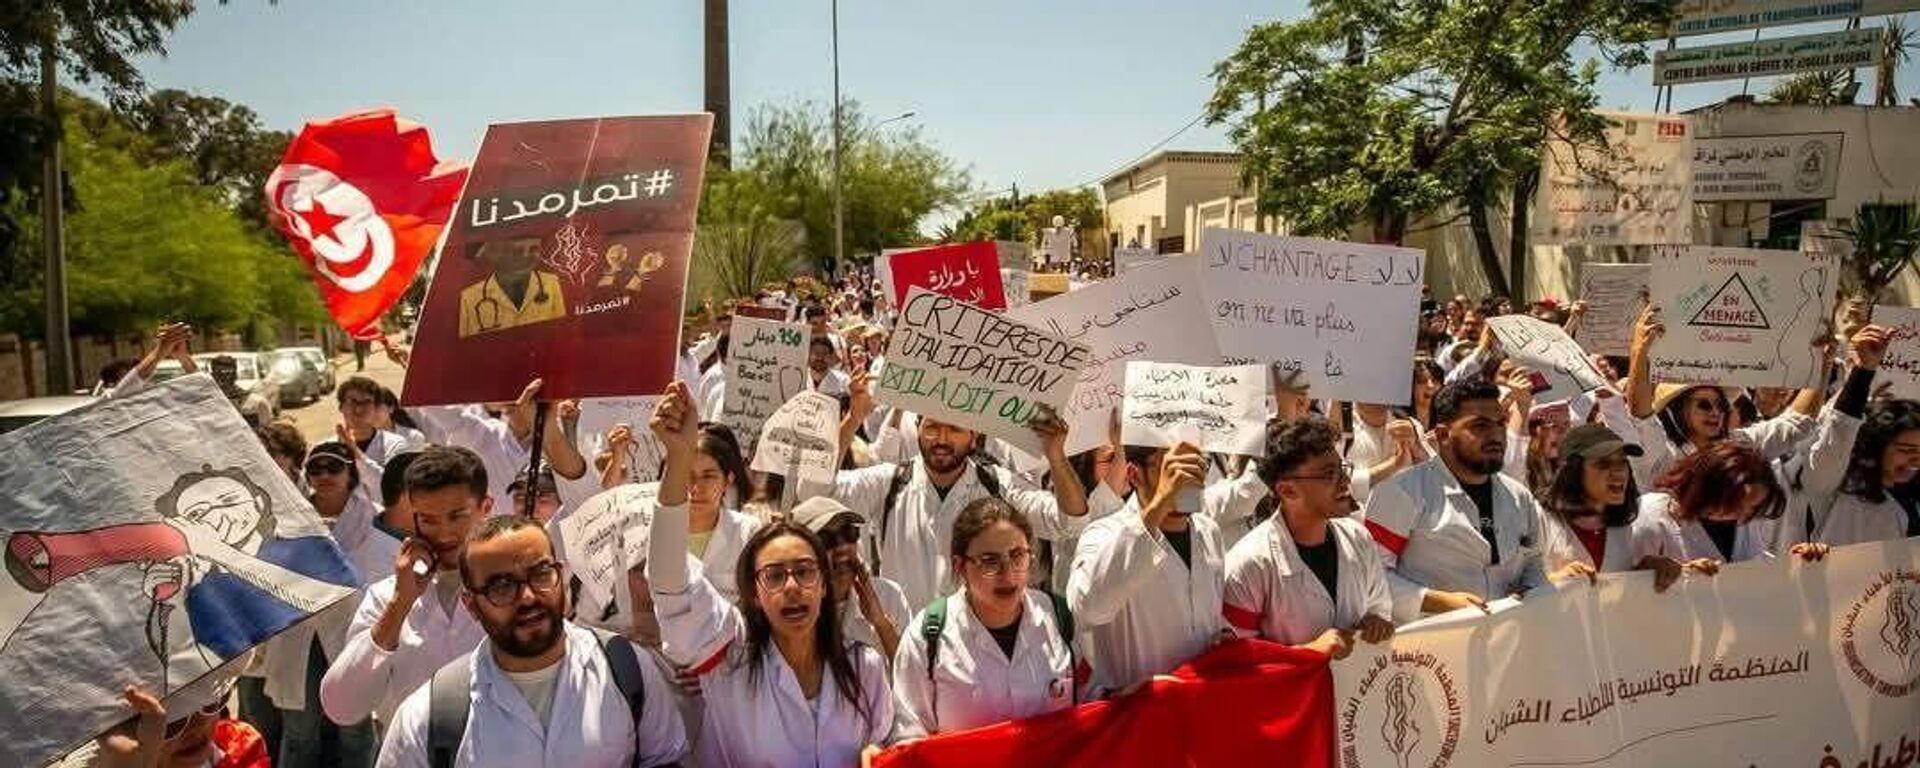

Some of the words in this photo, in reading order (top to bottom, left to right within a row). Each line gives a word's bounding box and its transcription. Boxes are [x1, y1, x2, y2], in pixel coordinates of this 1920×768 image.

[471, 168, 673, 227] #تمرمدنا
[1238, 242, 1358, 283] CHANTAGE
[574, 295, 631, 316] #تمرمدنا
[1703, 310, 1757, 323] MENACE
[1723, 294, 1740, 308] EN
[903, 292, 1050, 358] CRITERES
[1044, 341, 1089, 370] DE
[900, 327, 1064, 393] VALIDATION
[1618, 664, 1701, 701] التونسية
[1709, 650, 1810, 683] المنظمة
[1484, 699, 1552, 744] الشبان
